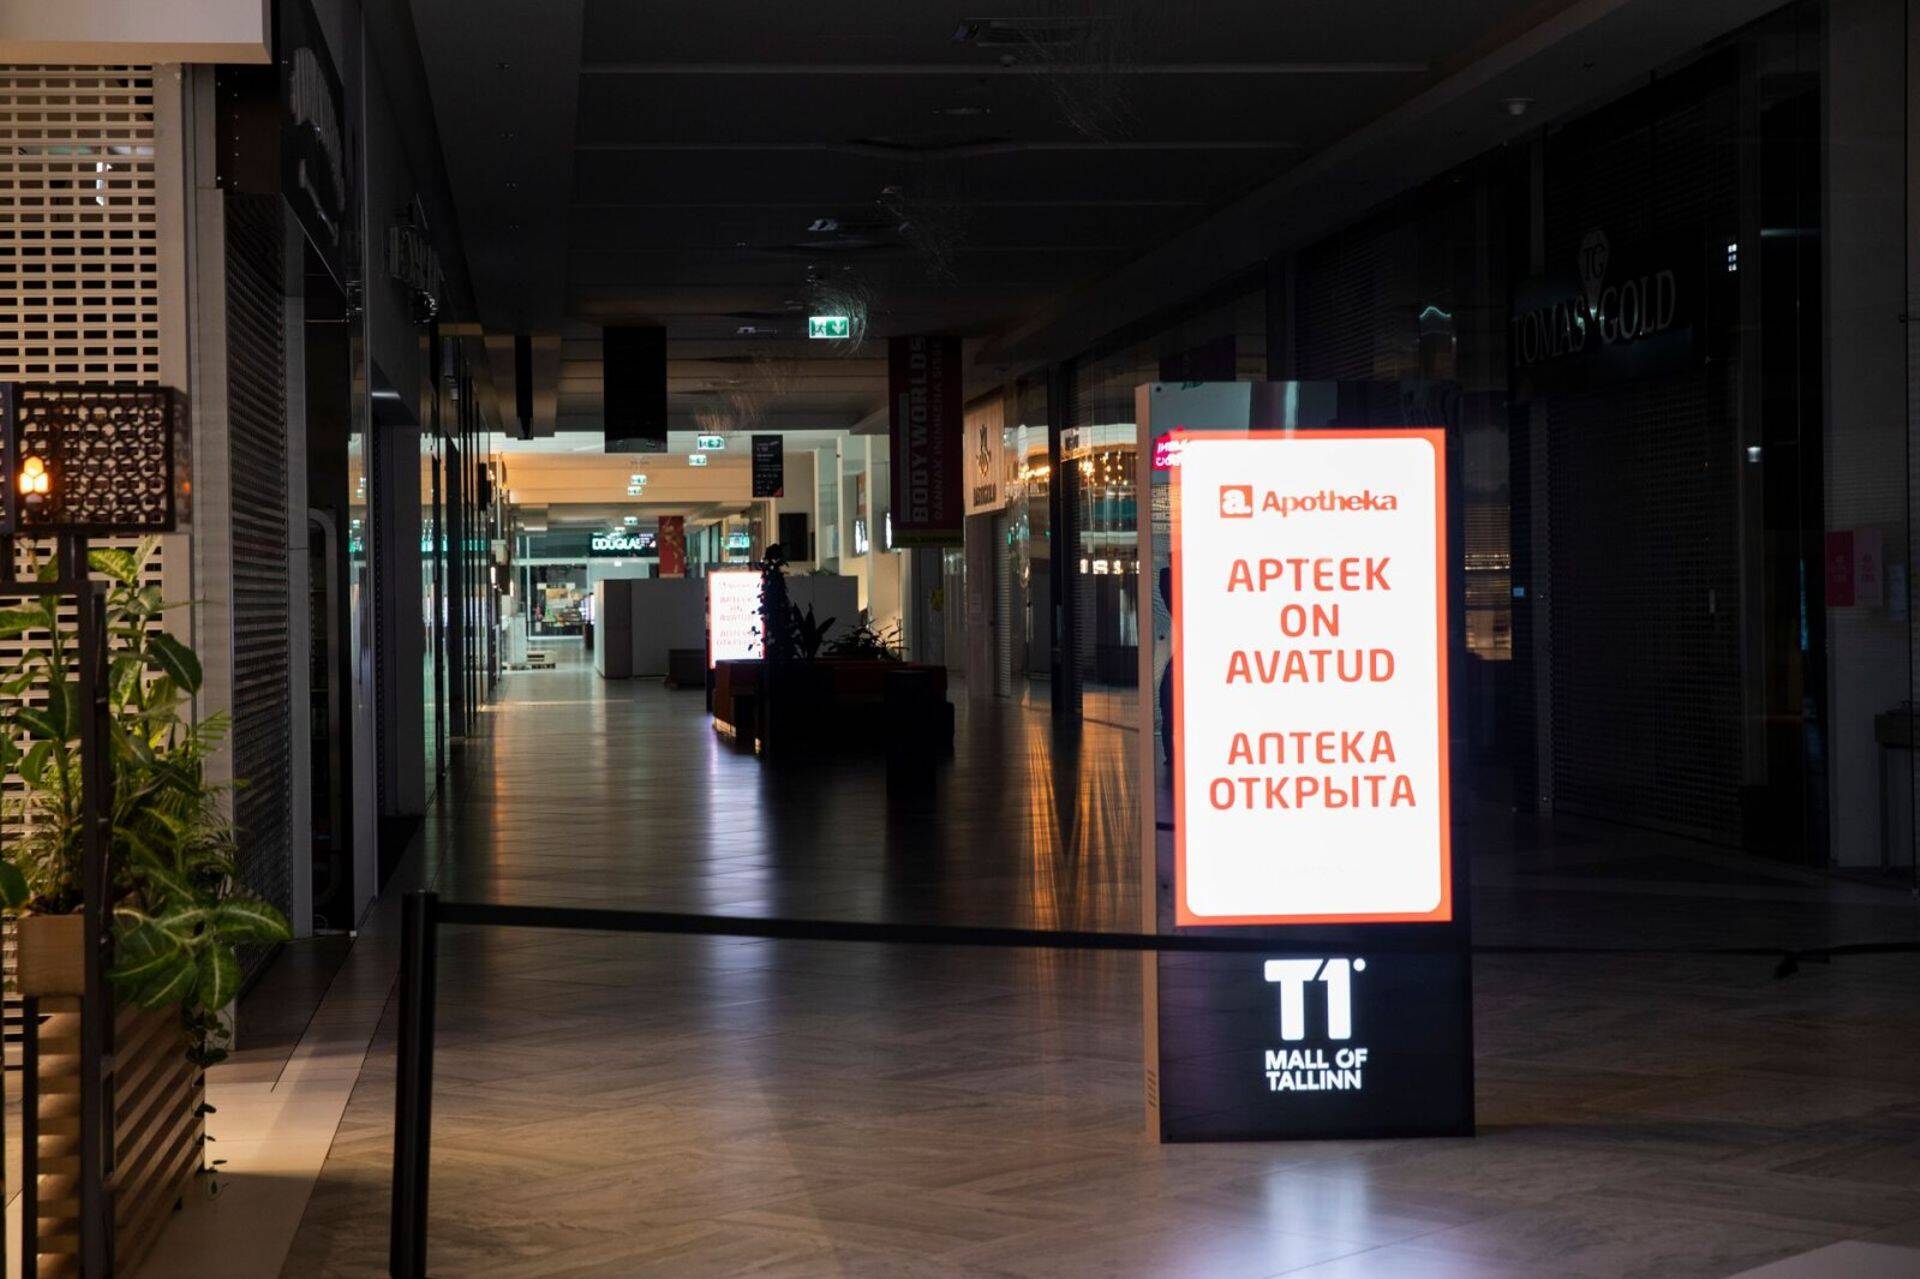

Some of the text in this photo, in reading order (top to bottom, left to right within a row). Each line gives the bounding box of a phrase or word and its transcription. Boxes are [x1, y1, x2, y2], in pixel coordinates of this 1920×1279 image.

[1510, 268, 1677, 368] TOMAS GOLD
[909, 335, 928, 523] BODY WORLDS
[1262, 490, 1398, 518] Apotheka
[1228, 557, 1391, 592] APTEEK
[1280, 604, 1340, 638] ON
[1227, 648, 1395, 684] AVATUD
[1229, 730, 1396, 766] АПТЕКА
[1210, 774, 1416, 811] ОТКРЫТА
[1265, 1047, 1368, 1071] MALL OF
[1266, 1069, 1362, 1092] TALLINN
